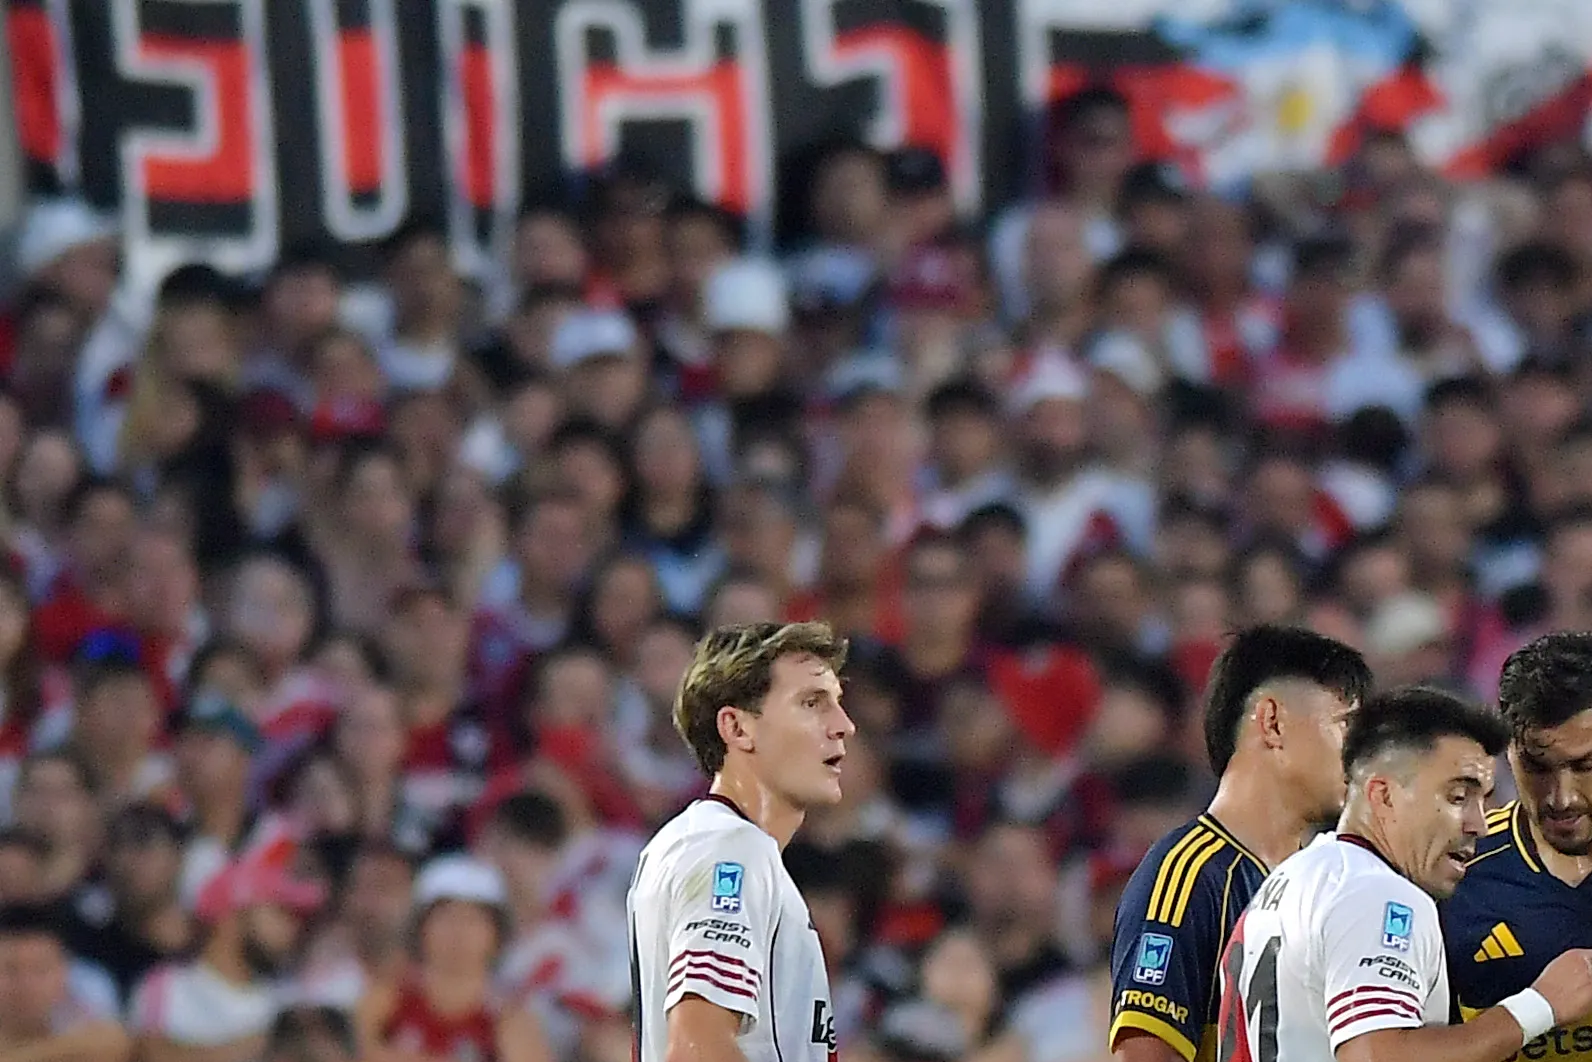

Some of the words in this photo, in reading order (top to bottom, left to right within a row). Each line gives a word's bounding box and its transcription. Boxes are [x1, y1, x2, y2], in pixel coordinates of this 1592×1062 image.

[712, 897, 740, 910] LPF
[684, 919, 751, 933] ASSIST
[1136, 967, 1163, 982] LPF
[1115, 990, 1189, 1024] TROGAR
